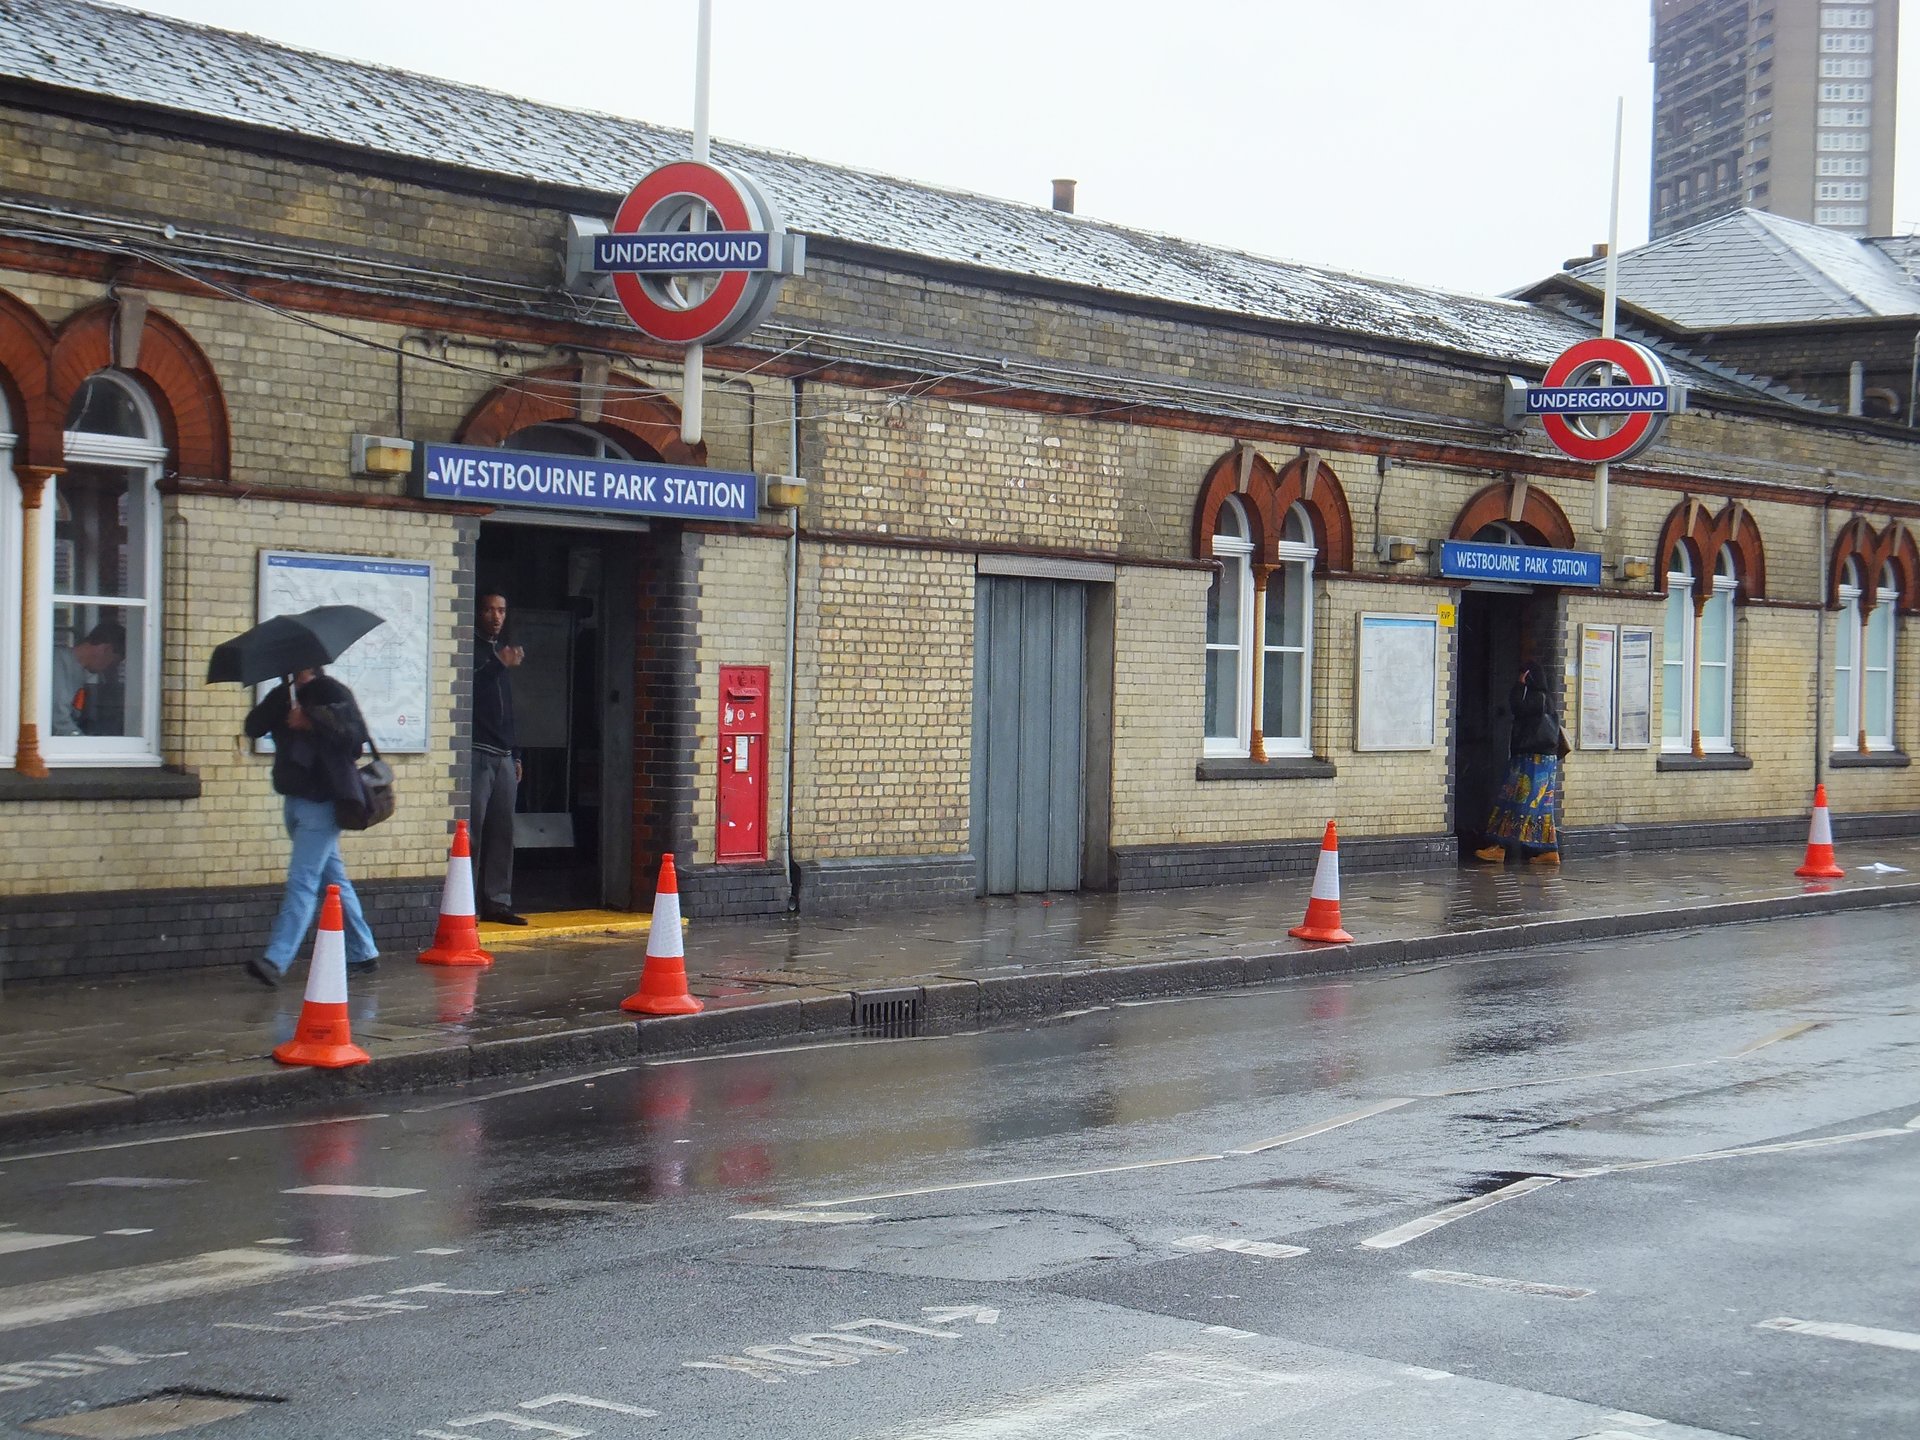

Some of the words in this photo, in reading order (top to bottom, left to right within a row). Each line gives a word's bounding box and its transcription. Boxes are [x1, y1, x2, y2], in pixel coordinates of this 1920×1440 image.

[601, 241, 762, 264] UNDERGROUND
[1531, 391, 1664, 408] UNDERGROUND
[438, 456, 597, 497] WESTBOURNE
[603, 472, 657, 502] PARK
[663, 478, 746, 509] STATION
[1457, 551, 1520, 572] WESTBOURNE
[1524, 557, 1548, 574] PARK
[1552, 558, 1588, 576] STATION
[213, 1282, 505, 1332] LEFT
